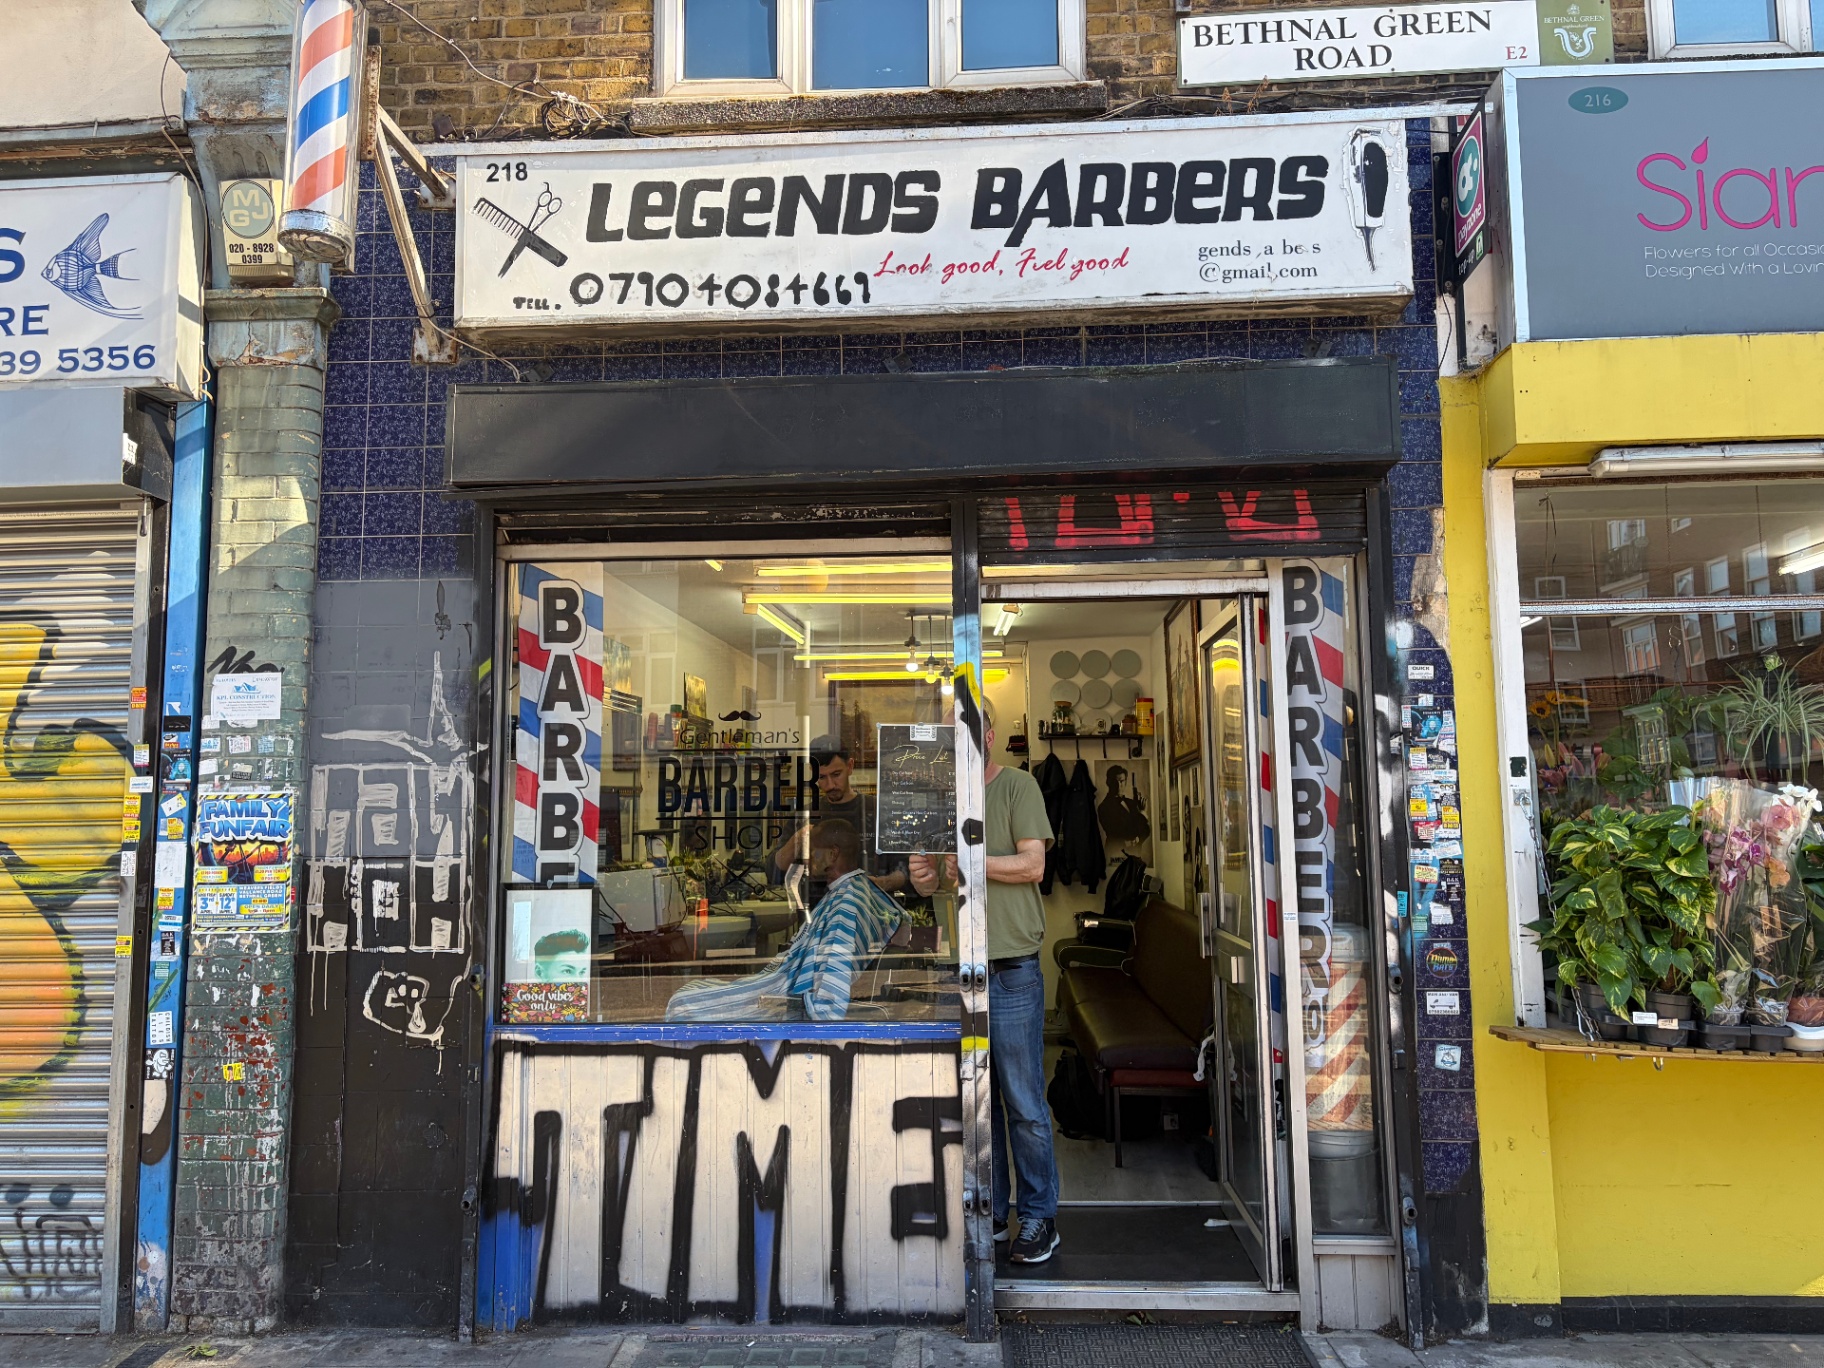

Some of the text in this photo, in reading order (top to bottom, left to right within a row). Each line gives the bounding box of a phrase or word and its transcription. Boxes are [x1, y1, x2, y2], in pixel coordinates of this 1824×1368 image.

[1192, 9, 1492, 48] BETHNAL GREEN
[1544, 16, 1578, 24] BETHNAL
[1293, 44, 1393, 72] ROAD
[1504, 46, 1528, 61] E2
[1584, 94, 1611, 107] 216
[486, 162, 528, 182] 218
[1457, 202, 1482, 245] payzone
[228, 243, 244, 253] 020
[252, 242, 275, 253] 8928
[1643, 246, 1712, 260] Flowers
[1715, 244, 1739, 258] for
[1743, 243, 1760, 257] all
[241, 254, 263, 264] 0399
[941, 249, 1004, 285] good,
[1070, 247, 1130, 281] good
[1645, 263, 1725, 280] Designed
[1728, 261, 1764, 275] With
[1768, 263, 1779, 275] a
[57, 344, 157, 374] 5356
[680, 727, 800, 745] Gentleman's
[657, 755, 820, 813] BARBER
[204, 799, 287, 820] FAMILY
[199, 819, 291, 840] FUNFAIR
[694, 825, 783, 851] SHOP
[516, 989, 546, 1003] Good
[530, 1000, 556, 1014] only
